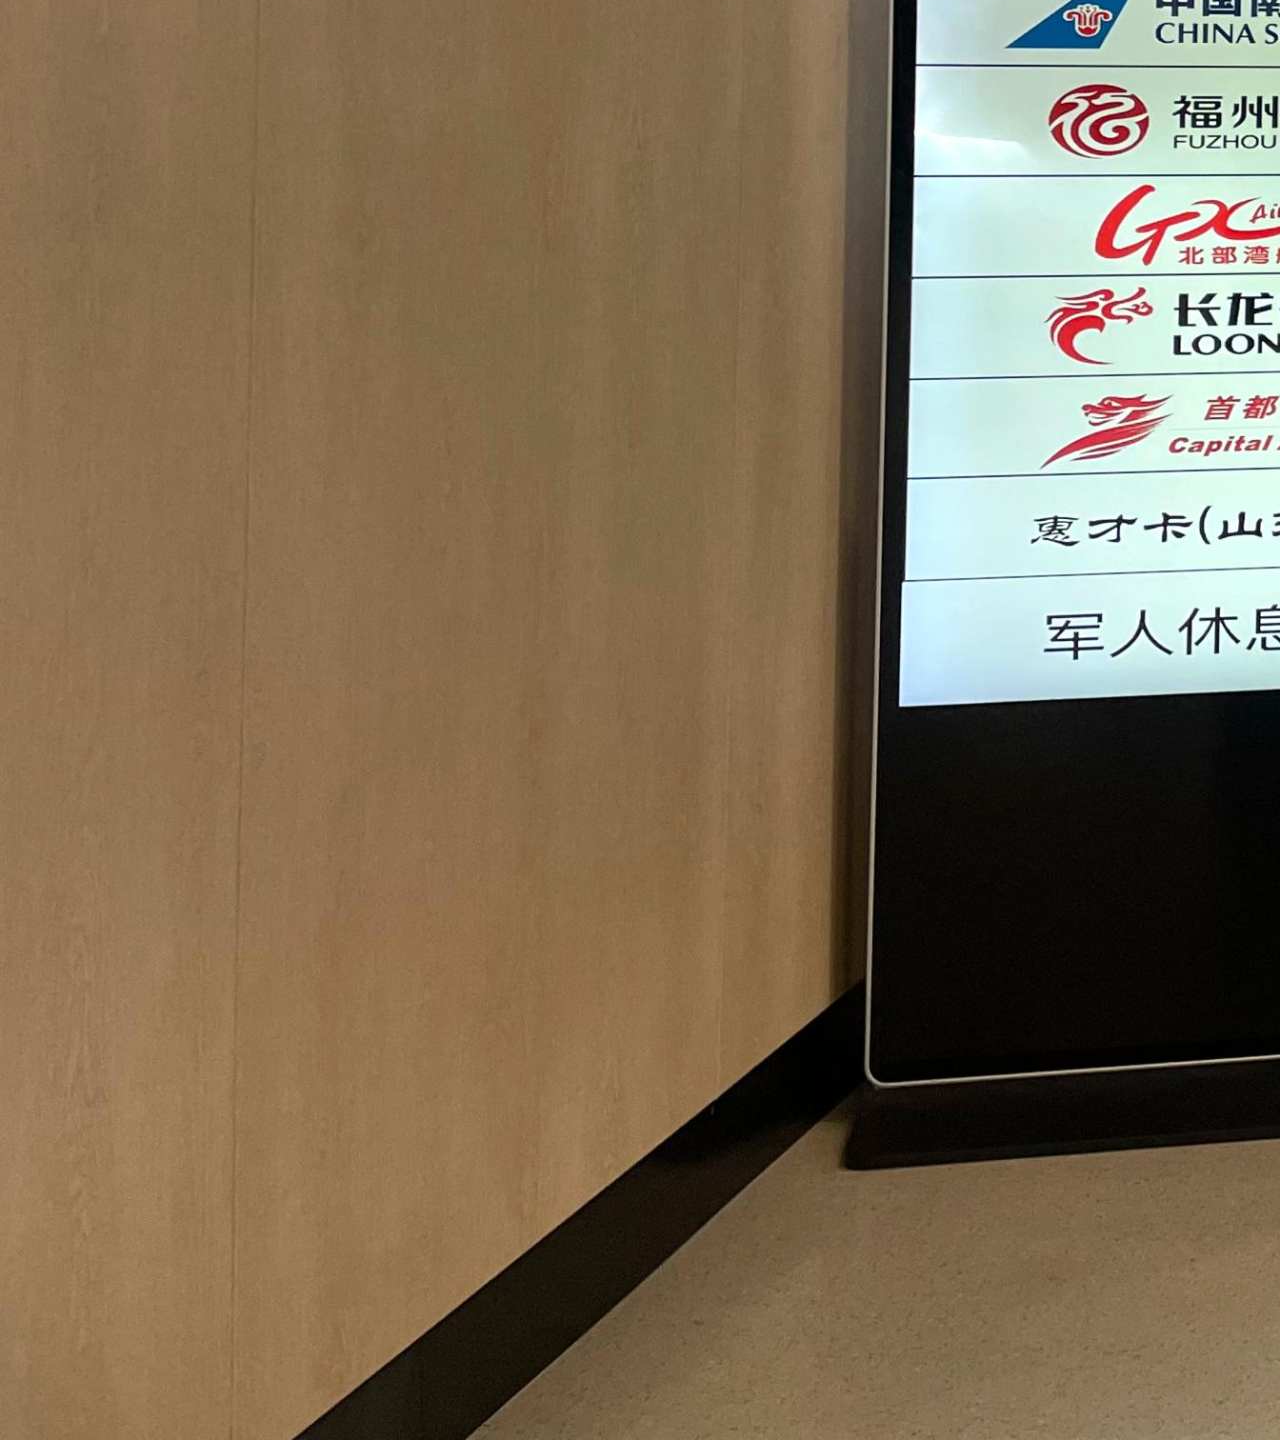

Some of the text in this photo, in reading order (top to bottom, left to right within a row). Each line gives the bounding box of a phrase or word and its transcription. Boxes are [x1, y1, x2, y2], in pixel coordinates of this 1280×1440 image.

[1155, 22, 1257, 45] CHINA
[1173, 134, 1280, 150] FUZHOU
[1168, 433, 1273, 456] Capital
